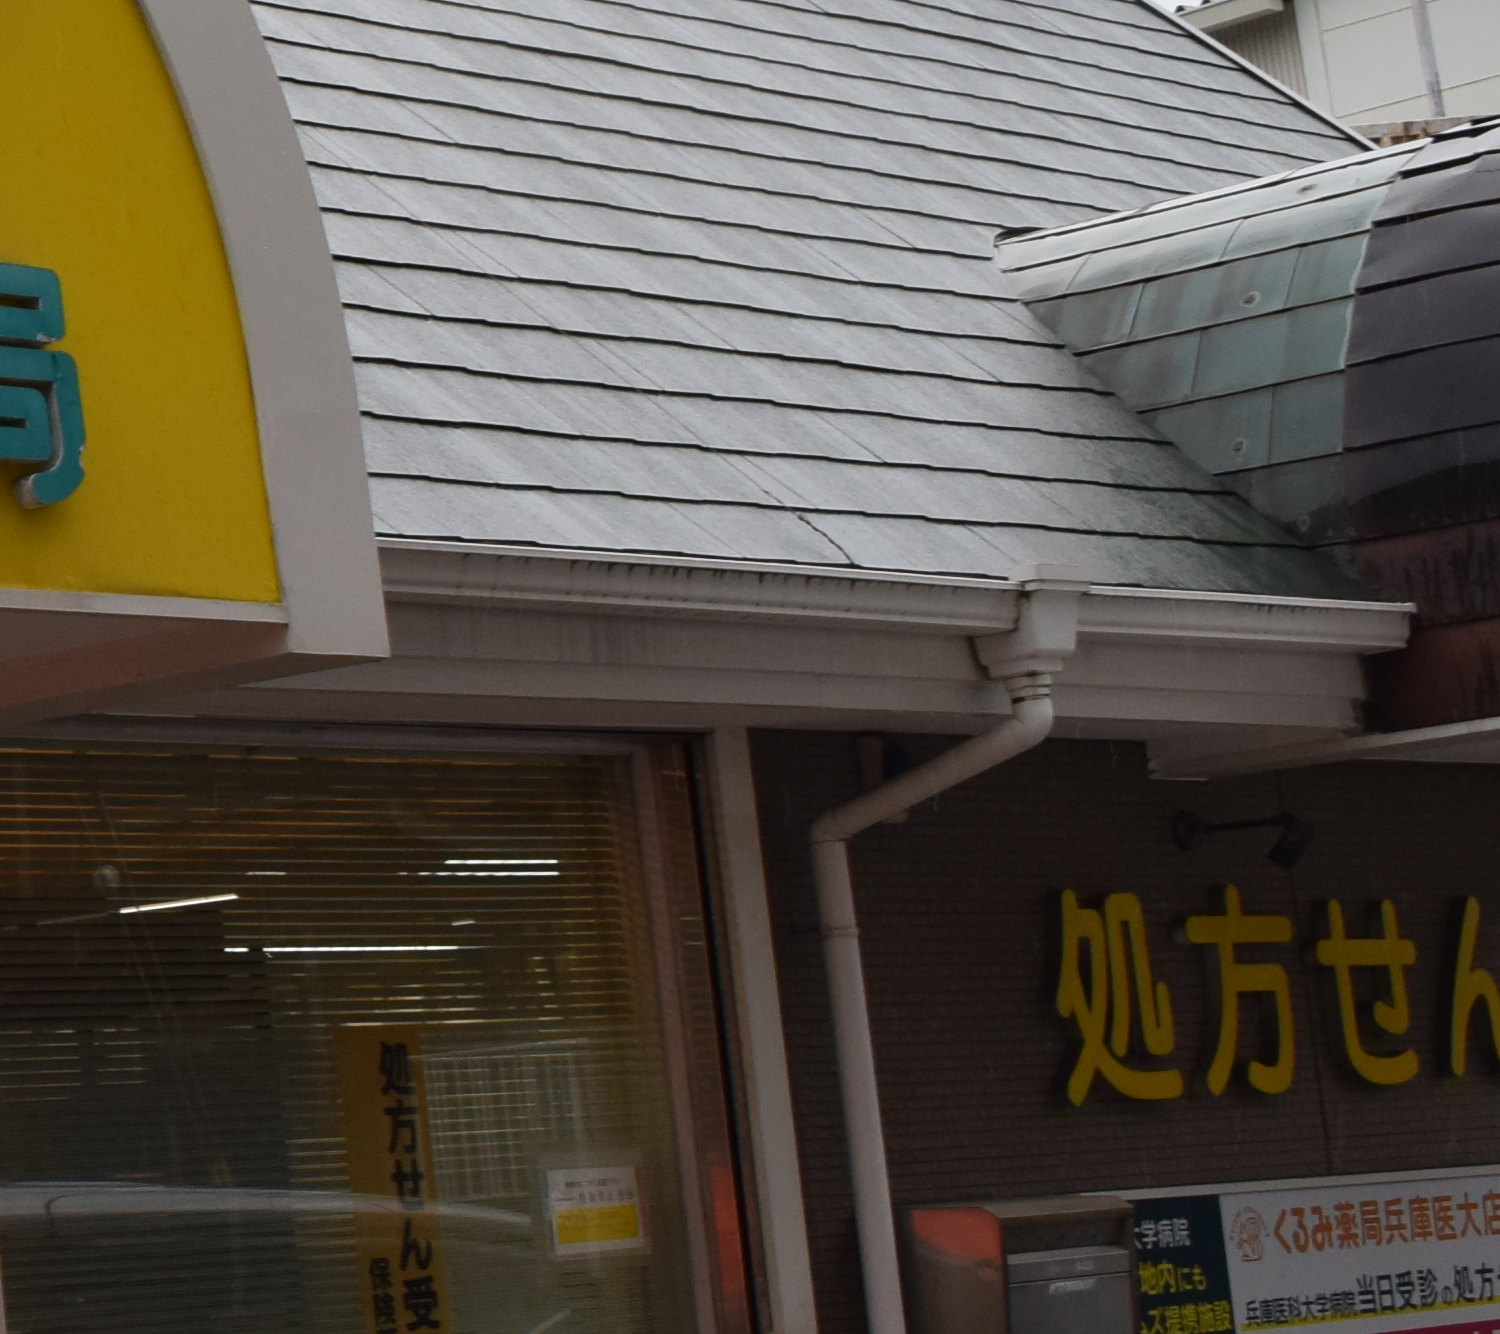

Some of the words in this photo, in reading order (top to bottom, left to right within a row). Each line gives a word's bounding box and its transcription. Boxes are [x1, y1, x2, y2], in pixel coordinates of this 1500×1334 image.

[1273, 1189, 1500, 1255] くるみ薬局兵庫医大店
[1245, 1263, 1500, 1328] 兵庫医科大学病院当日受診の処方
